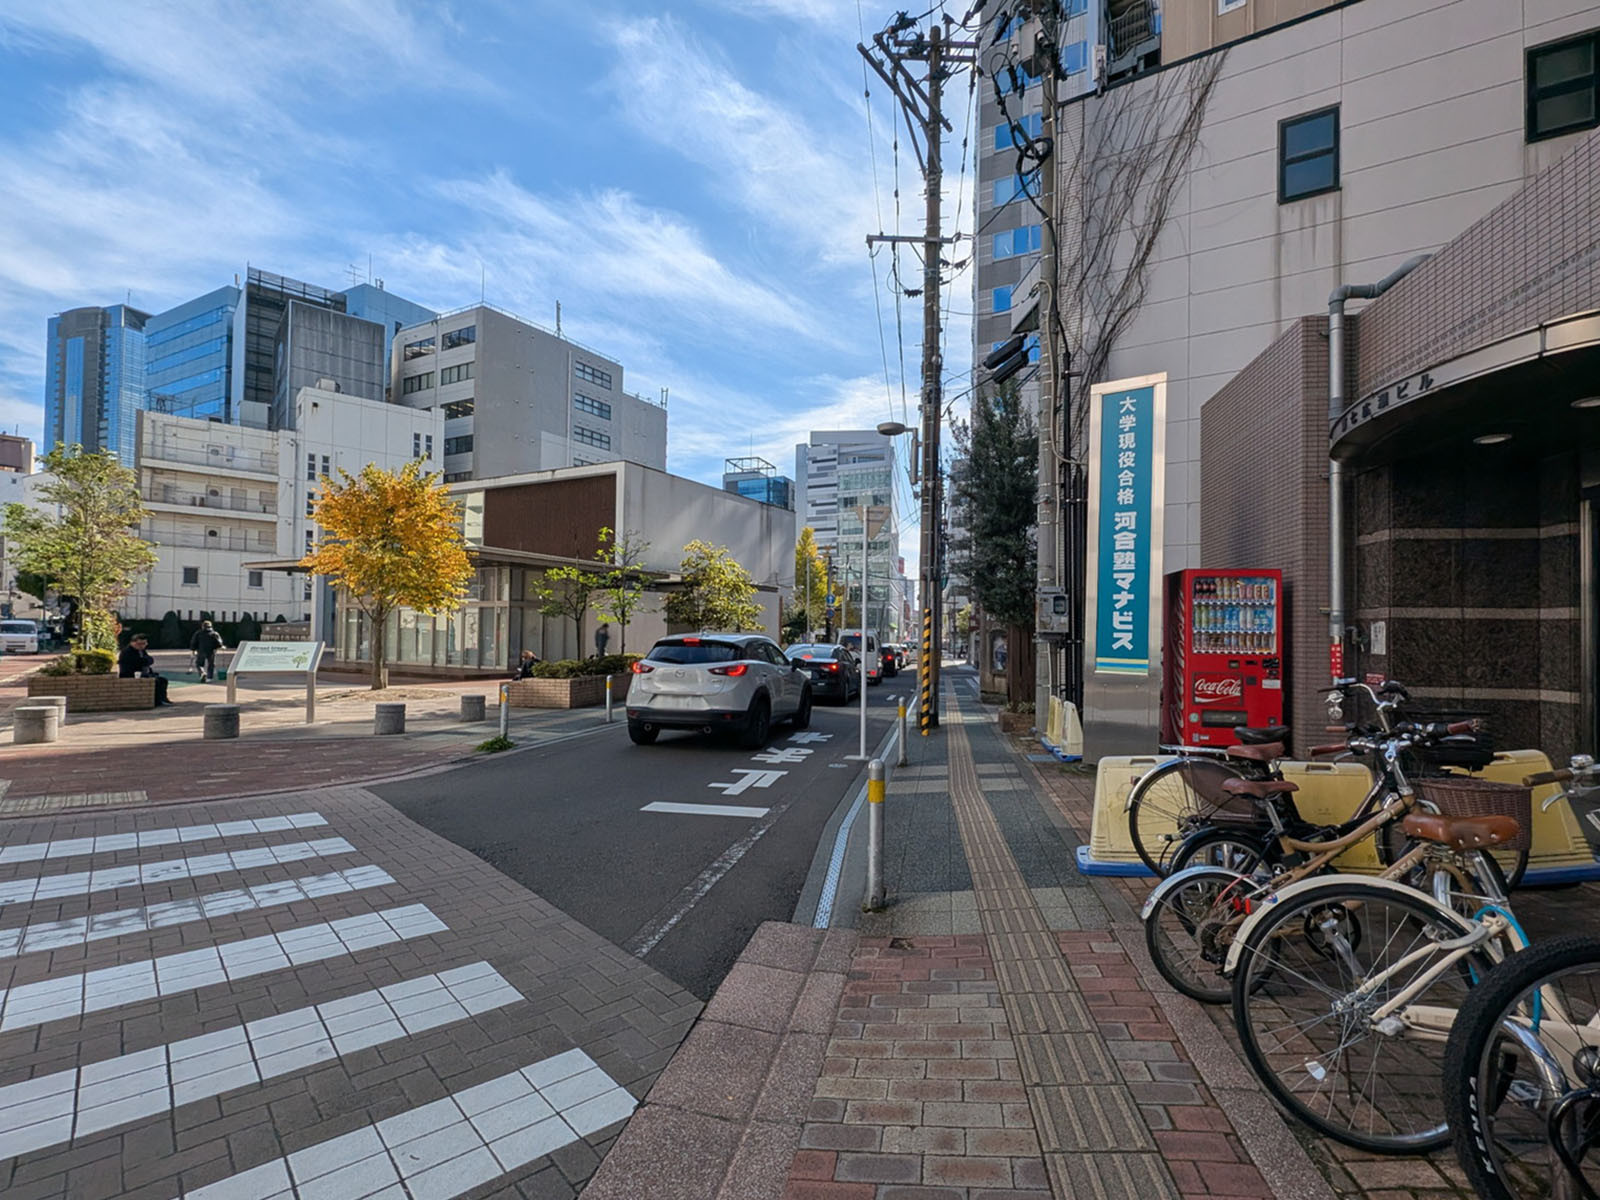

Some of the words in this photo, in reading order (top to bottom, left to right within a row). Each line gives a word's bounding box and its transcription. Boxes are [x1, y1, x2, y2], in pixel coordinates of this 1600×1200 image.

[1116, 396, 1137, 505] 大学現役合格
[1111, 511, 1137, 650] 河合塾マナビス
[1194, 678, 1241, 696] Coca-Cola
[1469, 1076, 1496, 1174] KENDA
